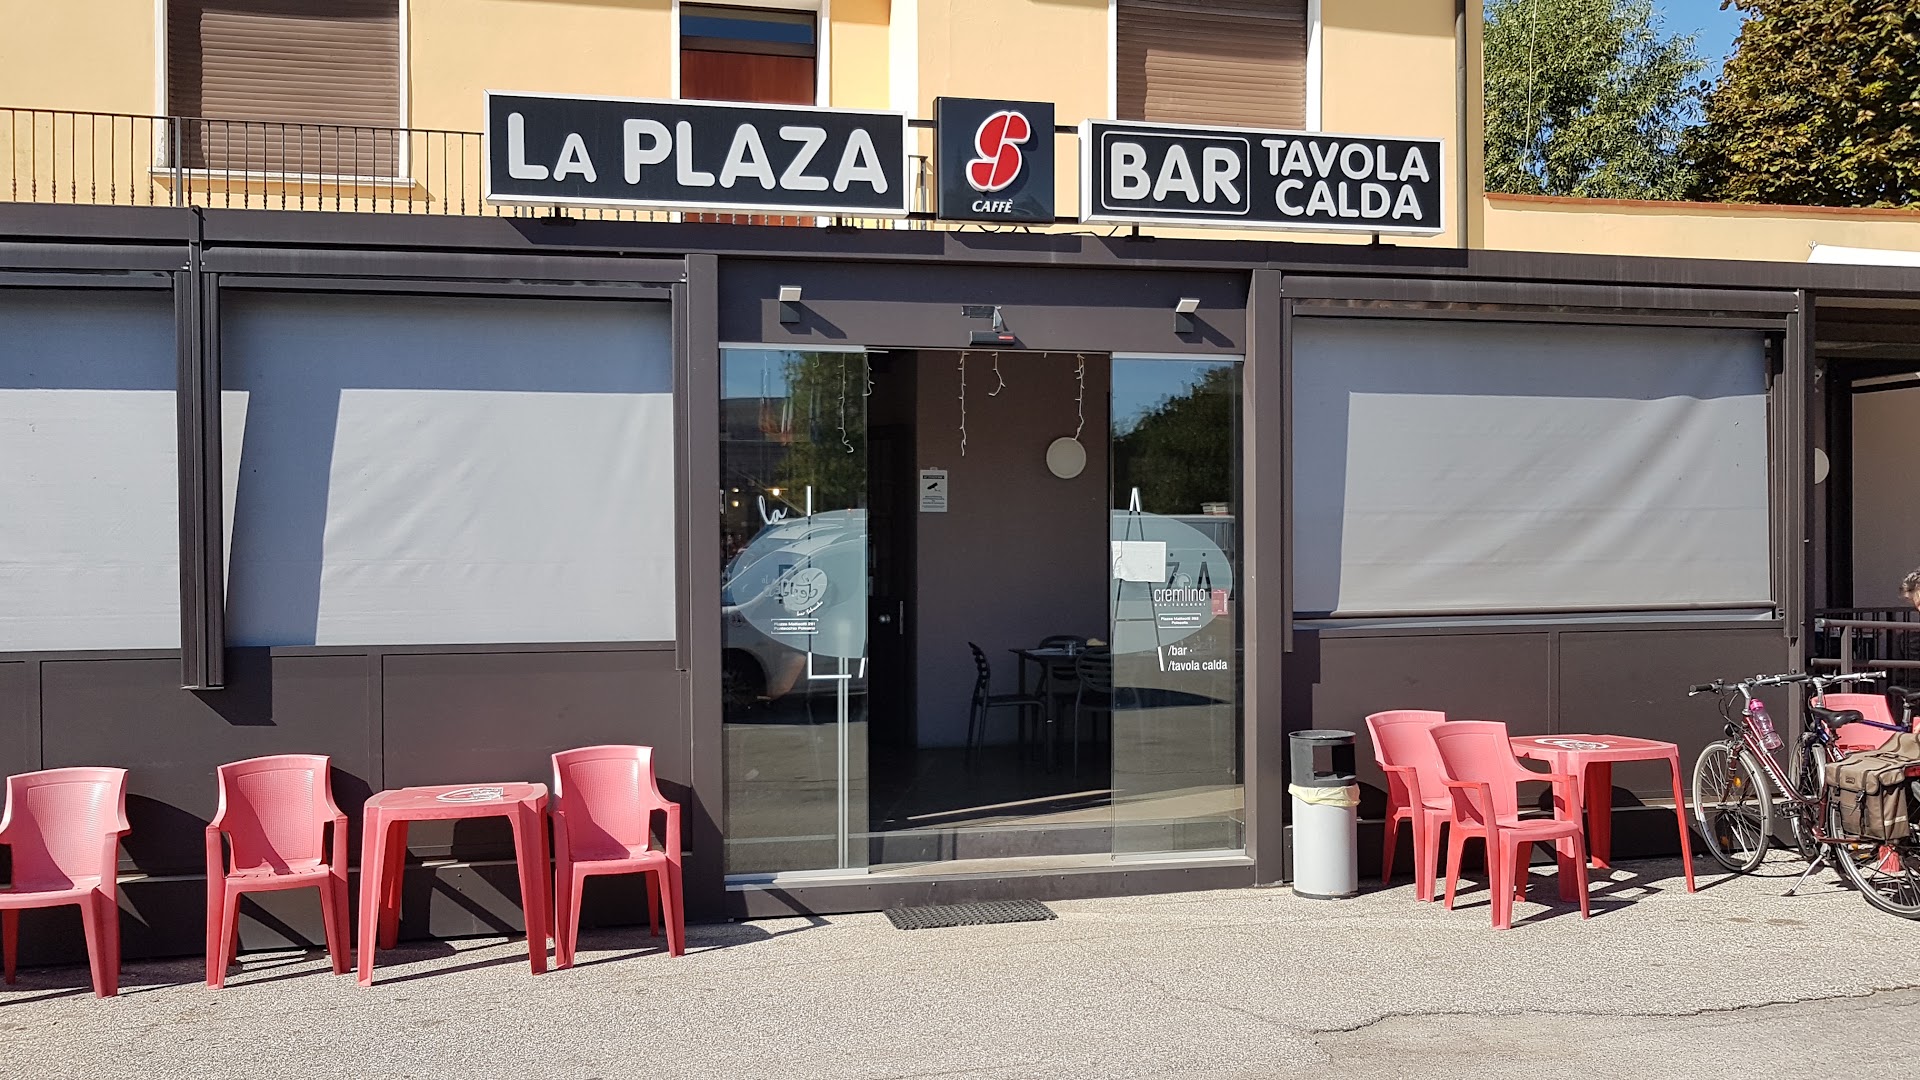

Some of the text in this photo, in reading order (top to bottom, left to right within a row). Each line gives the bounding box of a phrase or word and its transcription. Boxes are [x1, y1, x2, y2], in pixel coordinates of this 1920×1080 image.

[623, 118, 889, 194] PLAZA
[1110, 141, 1241, 204] BAR
[1260, 138, 1430, 183] TAVOLA
[971, 197, 1013, 214] CAFFÈ
[1275, 177, 1423, 221] CALDA
[1154, 586, 1206, 602] cremlino
[1202, 658, 1228, 671] calda
